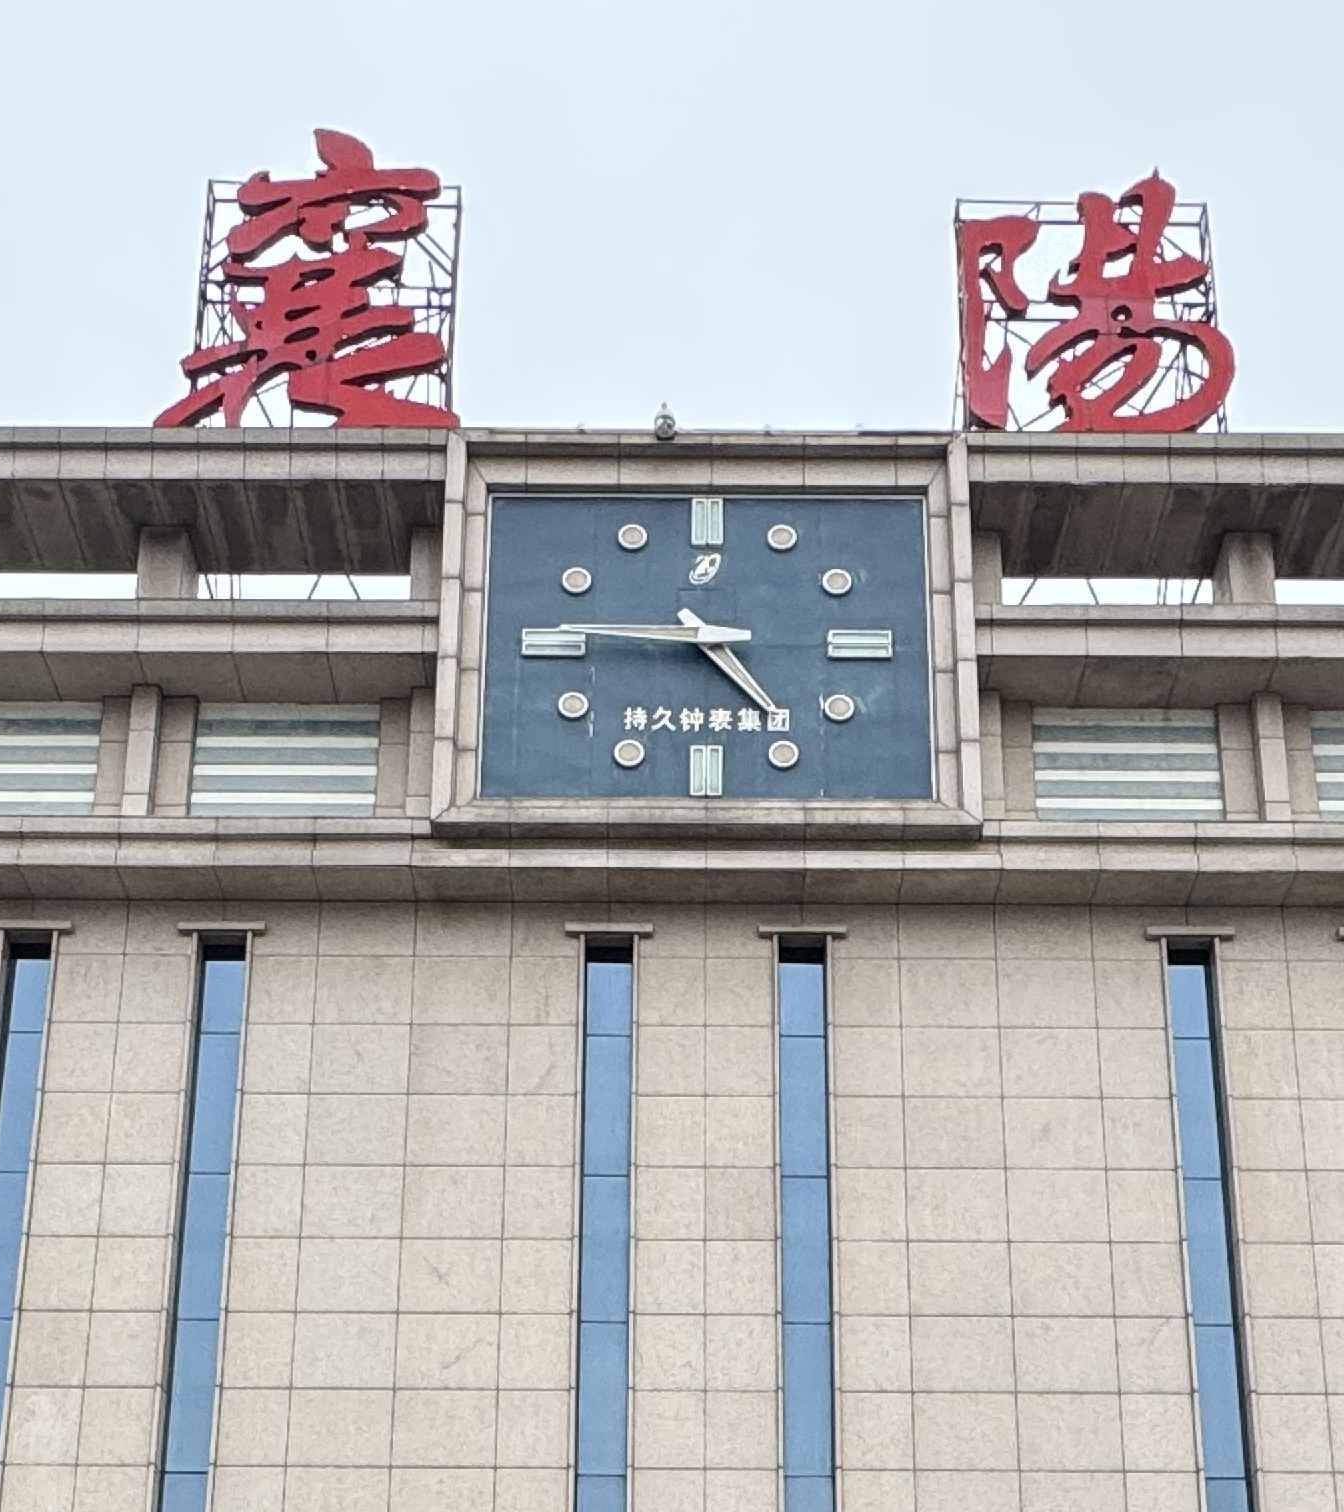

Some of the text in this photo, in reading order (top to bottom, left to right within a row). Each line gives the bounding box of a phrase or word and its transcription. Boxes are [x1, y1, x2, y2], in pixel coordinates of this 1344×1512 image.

[623, 706, 790, 733] 持久钟表集团
